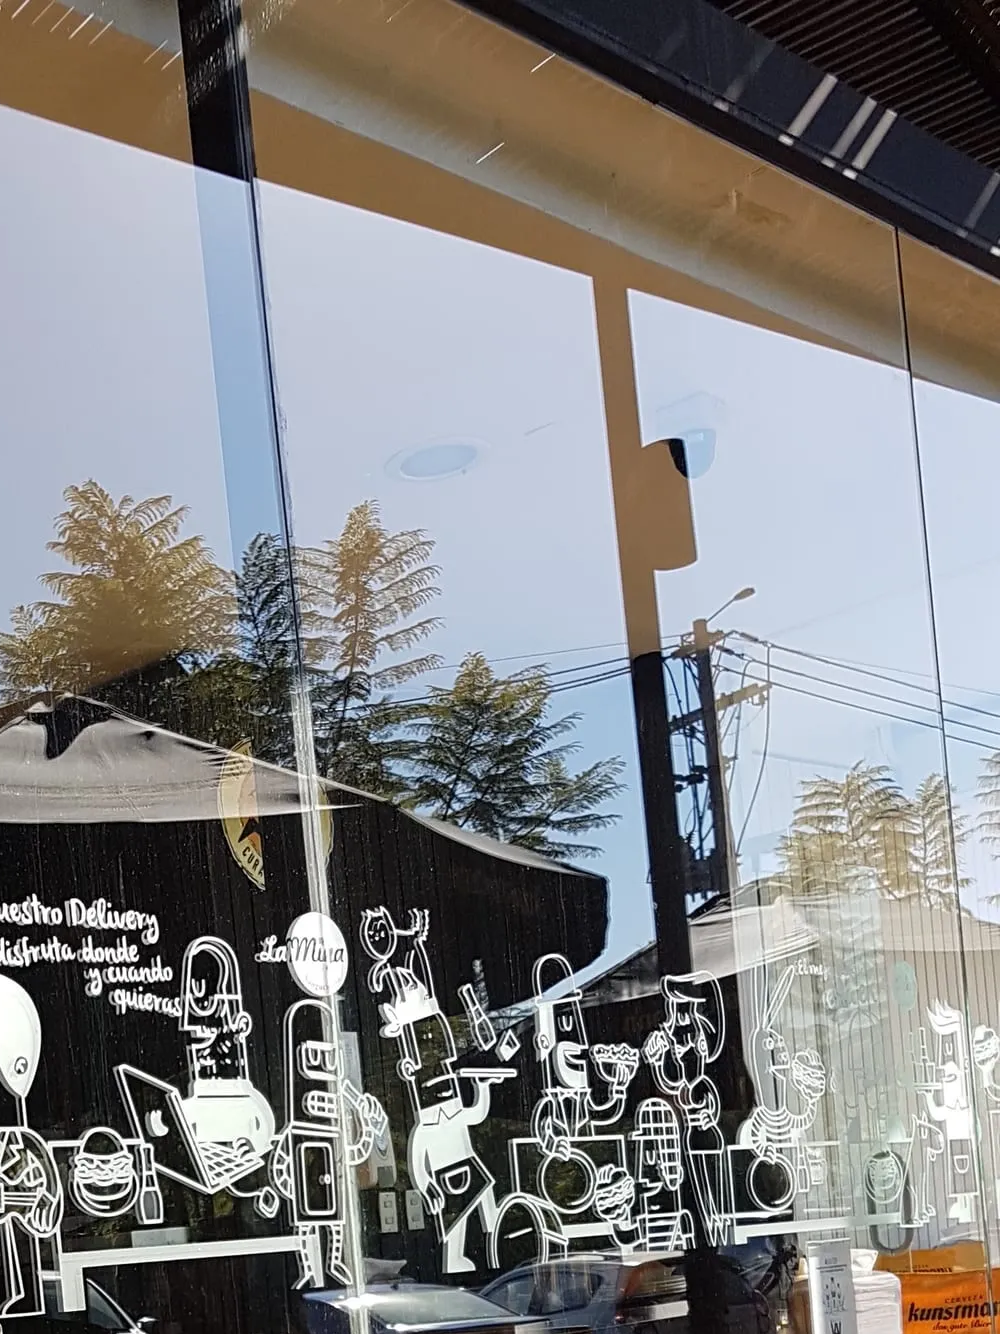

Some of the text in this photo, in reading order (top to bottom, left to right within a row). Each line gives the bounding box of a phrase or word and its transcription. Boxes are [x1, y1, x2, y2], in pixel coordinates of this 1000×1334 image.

[66, 898, 159, 945] Delivery
[78, 935, 139, 963] donde
[255, 935, 287, 962] La
[85, 955, 172, 996] y cuando
[110, 986, 182, 1016] quieras
